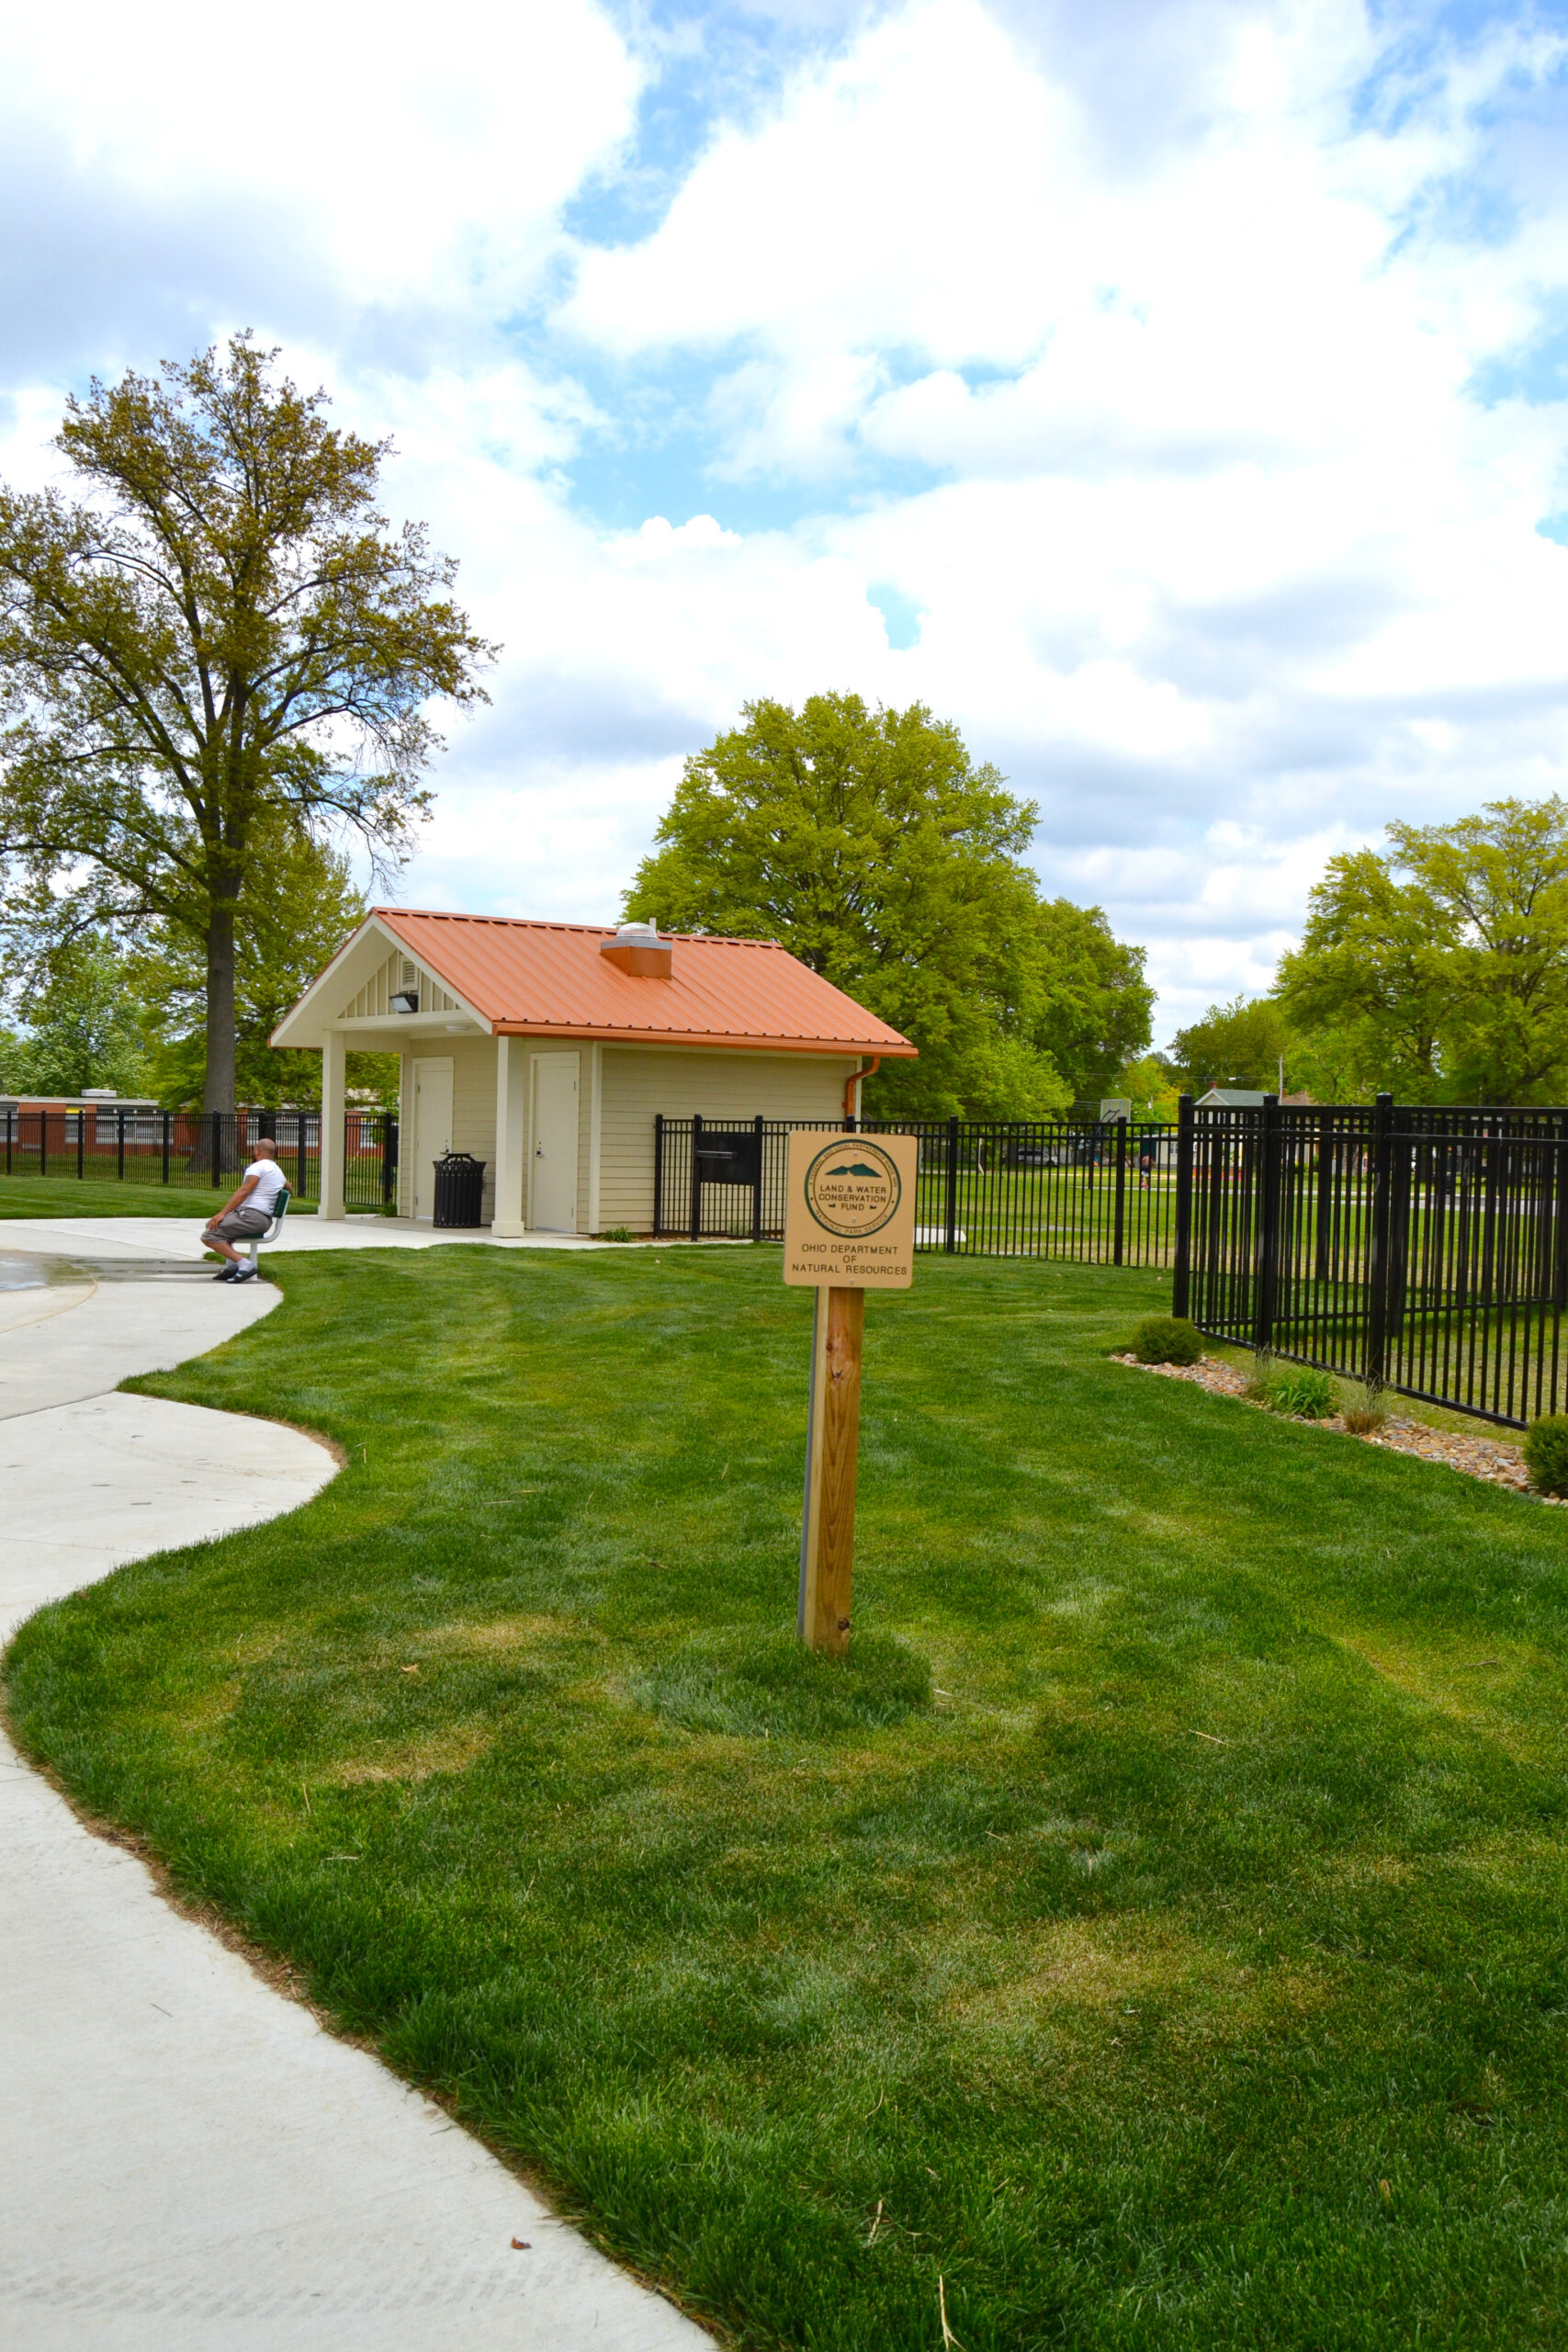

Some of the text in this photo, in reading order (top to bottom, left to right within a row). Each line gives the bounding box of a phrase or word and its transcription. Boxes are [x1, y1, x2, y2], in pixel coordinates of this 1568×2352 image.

[819, 1184, 844, 1193] LAND
[856, 1185, 886, 1194] WATER
[818, 1193, 886, 1204] CONSERVATION
[840, 1203, 865, 1211] FUND
[815, 1208, 841, 1233] NATIONAL
[801, 1243, 898, 1255] OHIO DEPARTMENT
[842, 1255, 857, 1264] OF
[792, 1263, 908, 1275] NATURAL RESOURCES
